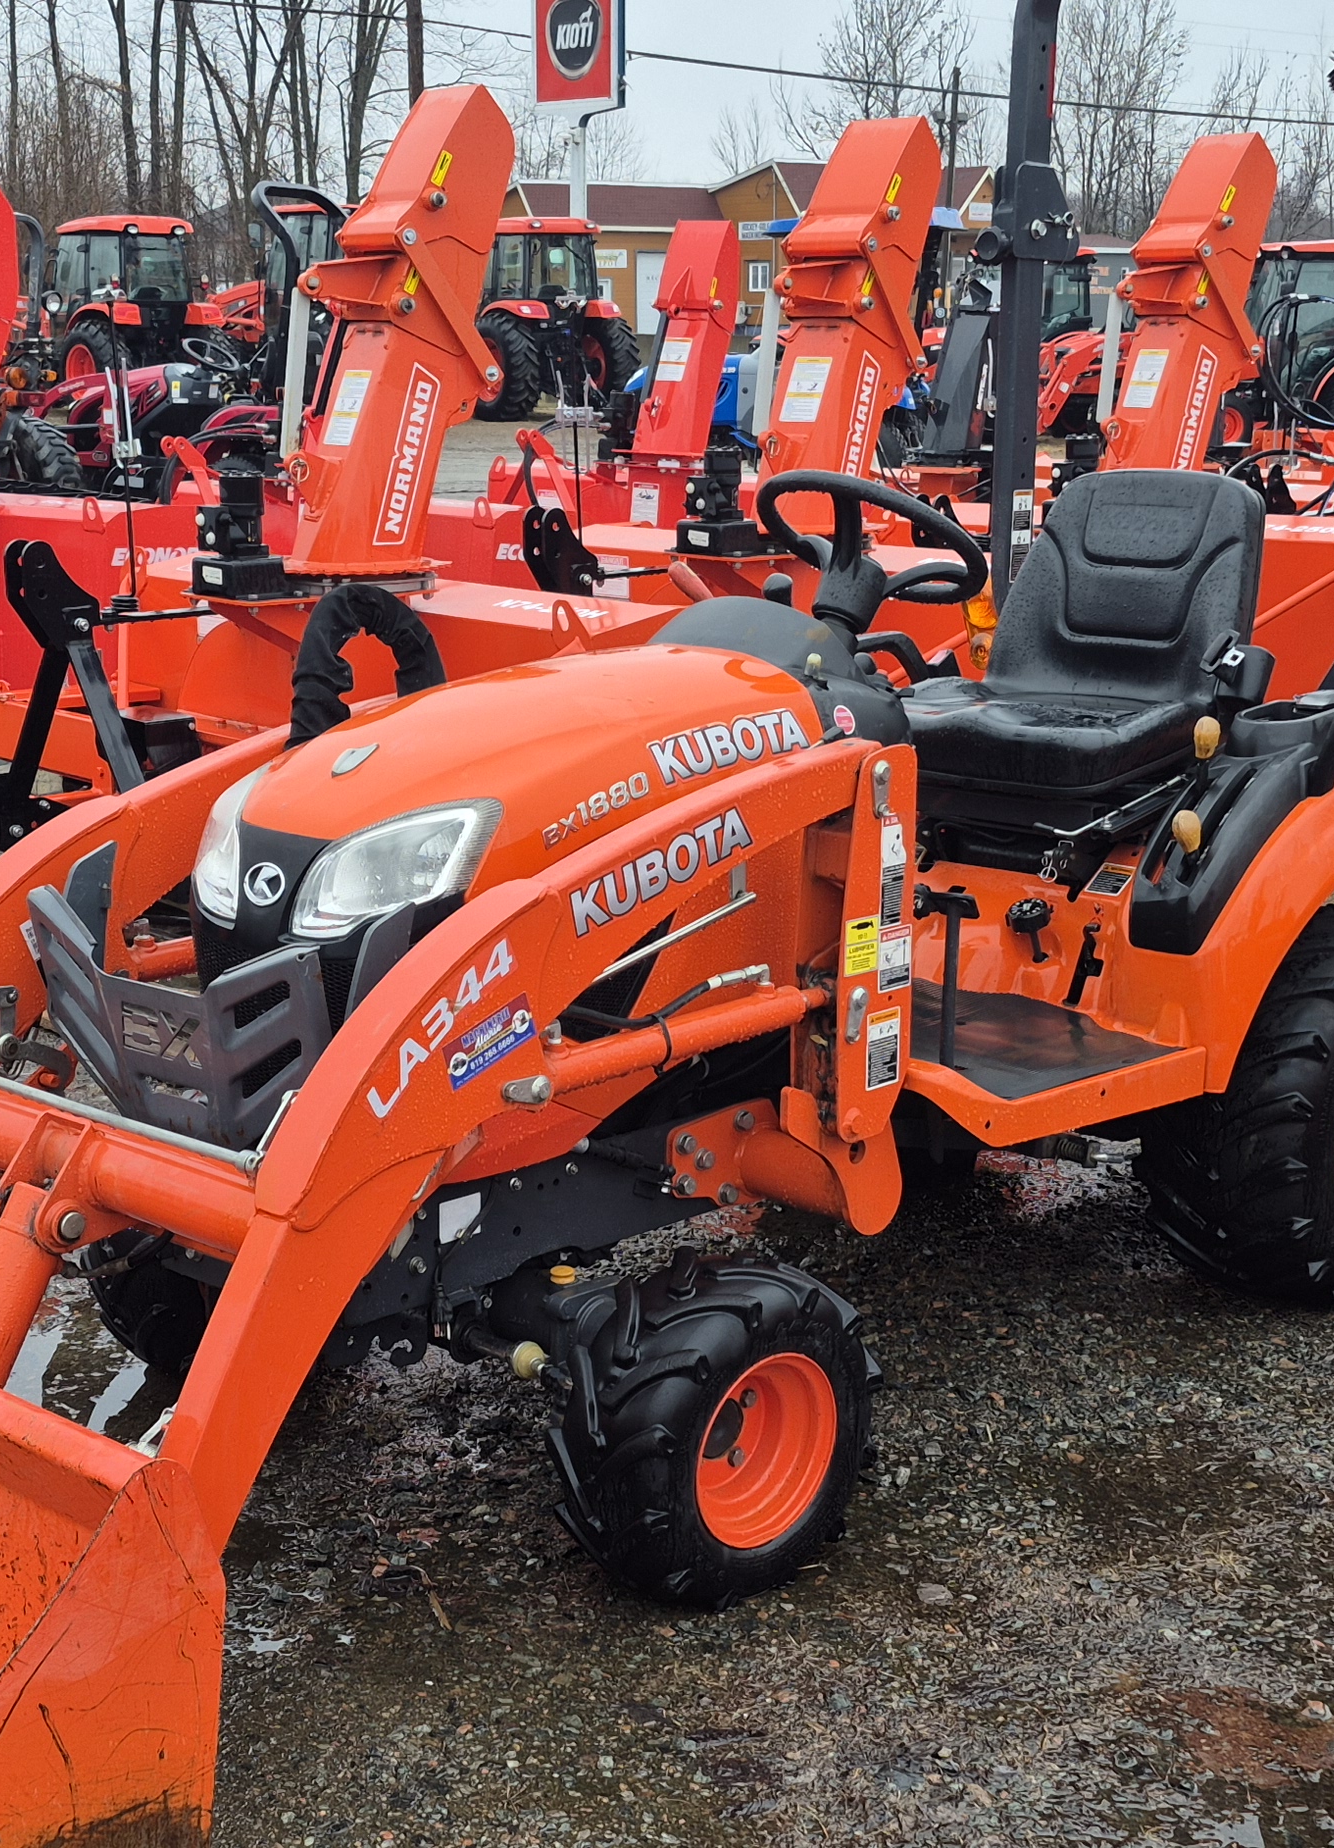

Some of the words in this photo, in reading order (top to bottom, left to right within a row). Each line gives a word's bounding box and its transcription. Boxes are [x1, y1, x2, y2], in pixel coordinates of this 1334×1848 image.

[555, 21, 594, 50] KIOTI
[385, 381, 433, 534] NORMAND
[845, 366, 876, 477] ORMAND
[648, 708, 811, 785] KUBOTA
[541, 771, 650, 850] BX1880
[570, 806, 753, 937] KUBOTA
[121, 1001, 203, 1069] BX
[367, 938, 513, 1118] LA344
